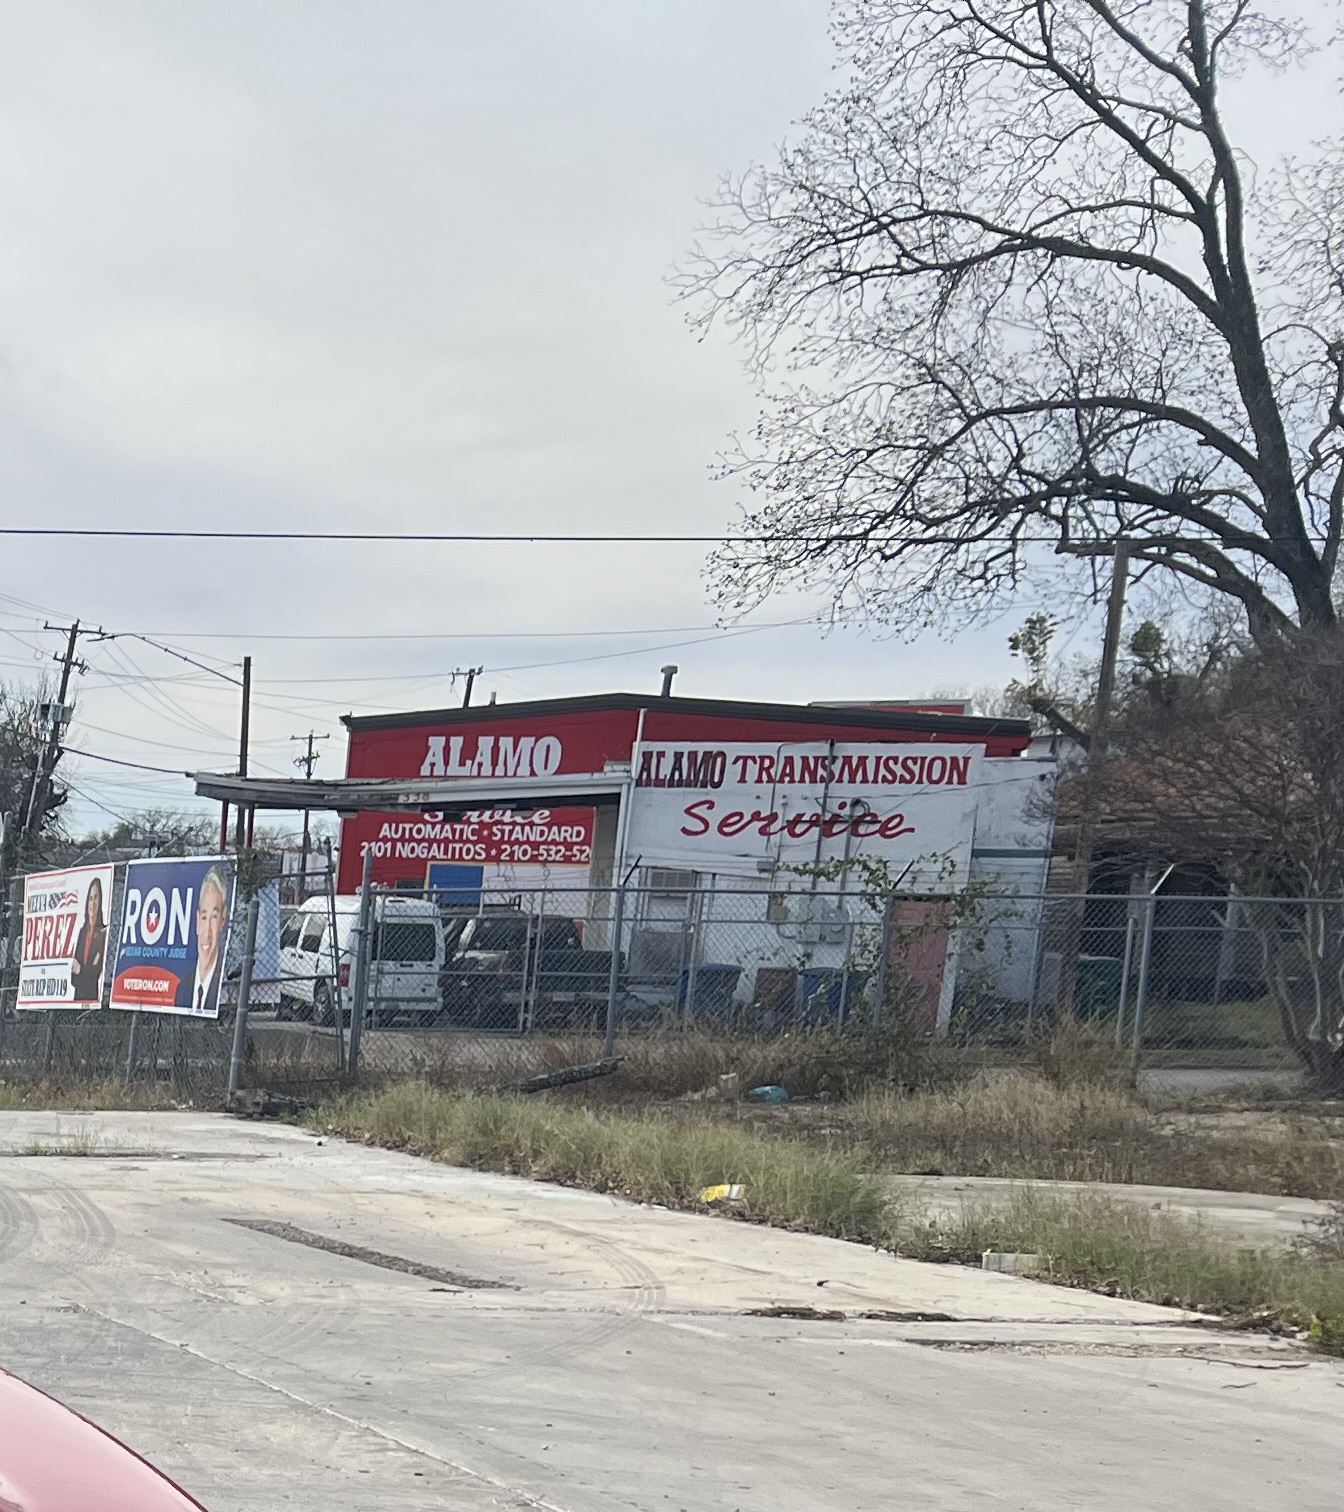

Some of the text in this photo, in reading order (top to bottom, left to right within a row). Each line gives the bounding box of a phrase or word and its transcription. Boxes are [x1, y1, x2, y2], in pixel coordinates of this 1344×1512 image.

[420, 736, 563, 777] ALAMO
[635, 750, 972, 788] ALAMO TRANSMISSION
[379, 823, 586, 843] AUTOMATIC STANDARD
[680, 800, 915, 839] Service
[395, 842, 487, 860] NOGALITOS
[500, 844, 592, 862] 210-532-52
[122, 886, 194, 946] RON
[23, 913, 78, 961] PEREZ
[142, 947, 169, 958] COUNTY
